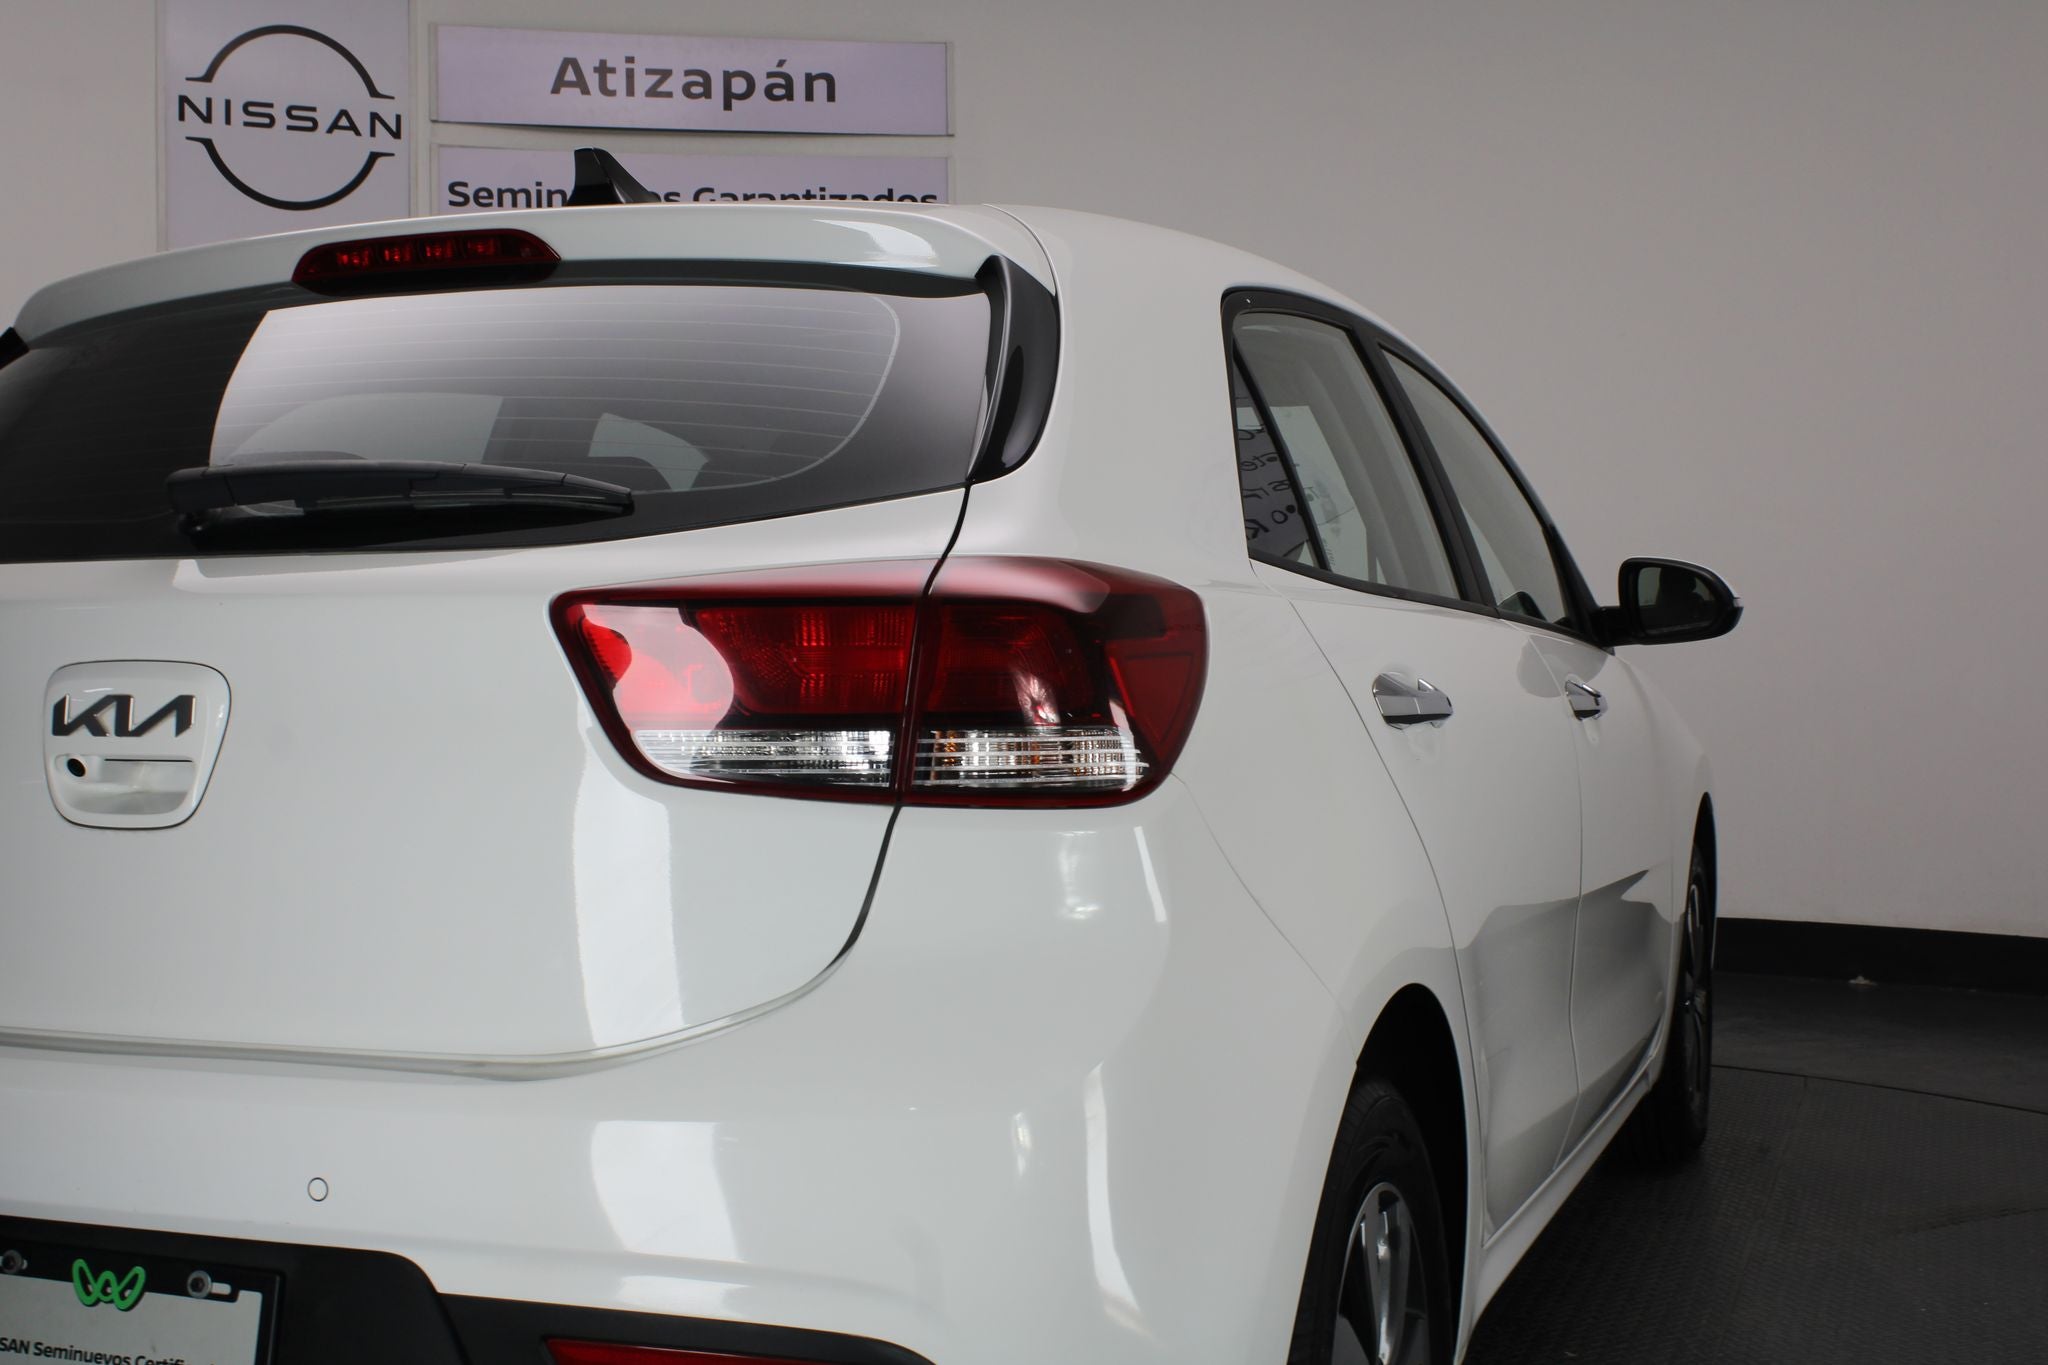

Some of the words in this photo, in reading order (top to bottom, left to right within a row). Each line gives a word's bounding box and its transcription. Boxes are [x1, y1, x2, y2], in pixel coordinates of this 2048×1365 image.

[550, 56, 836, 111] Atizapán
[178, 94, 402, 140] NISSAN
[52, 693, 195, 738] KIA
